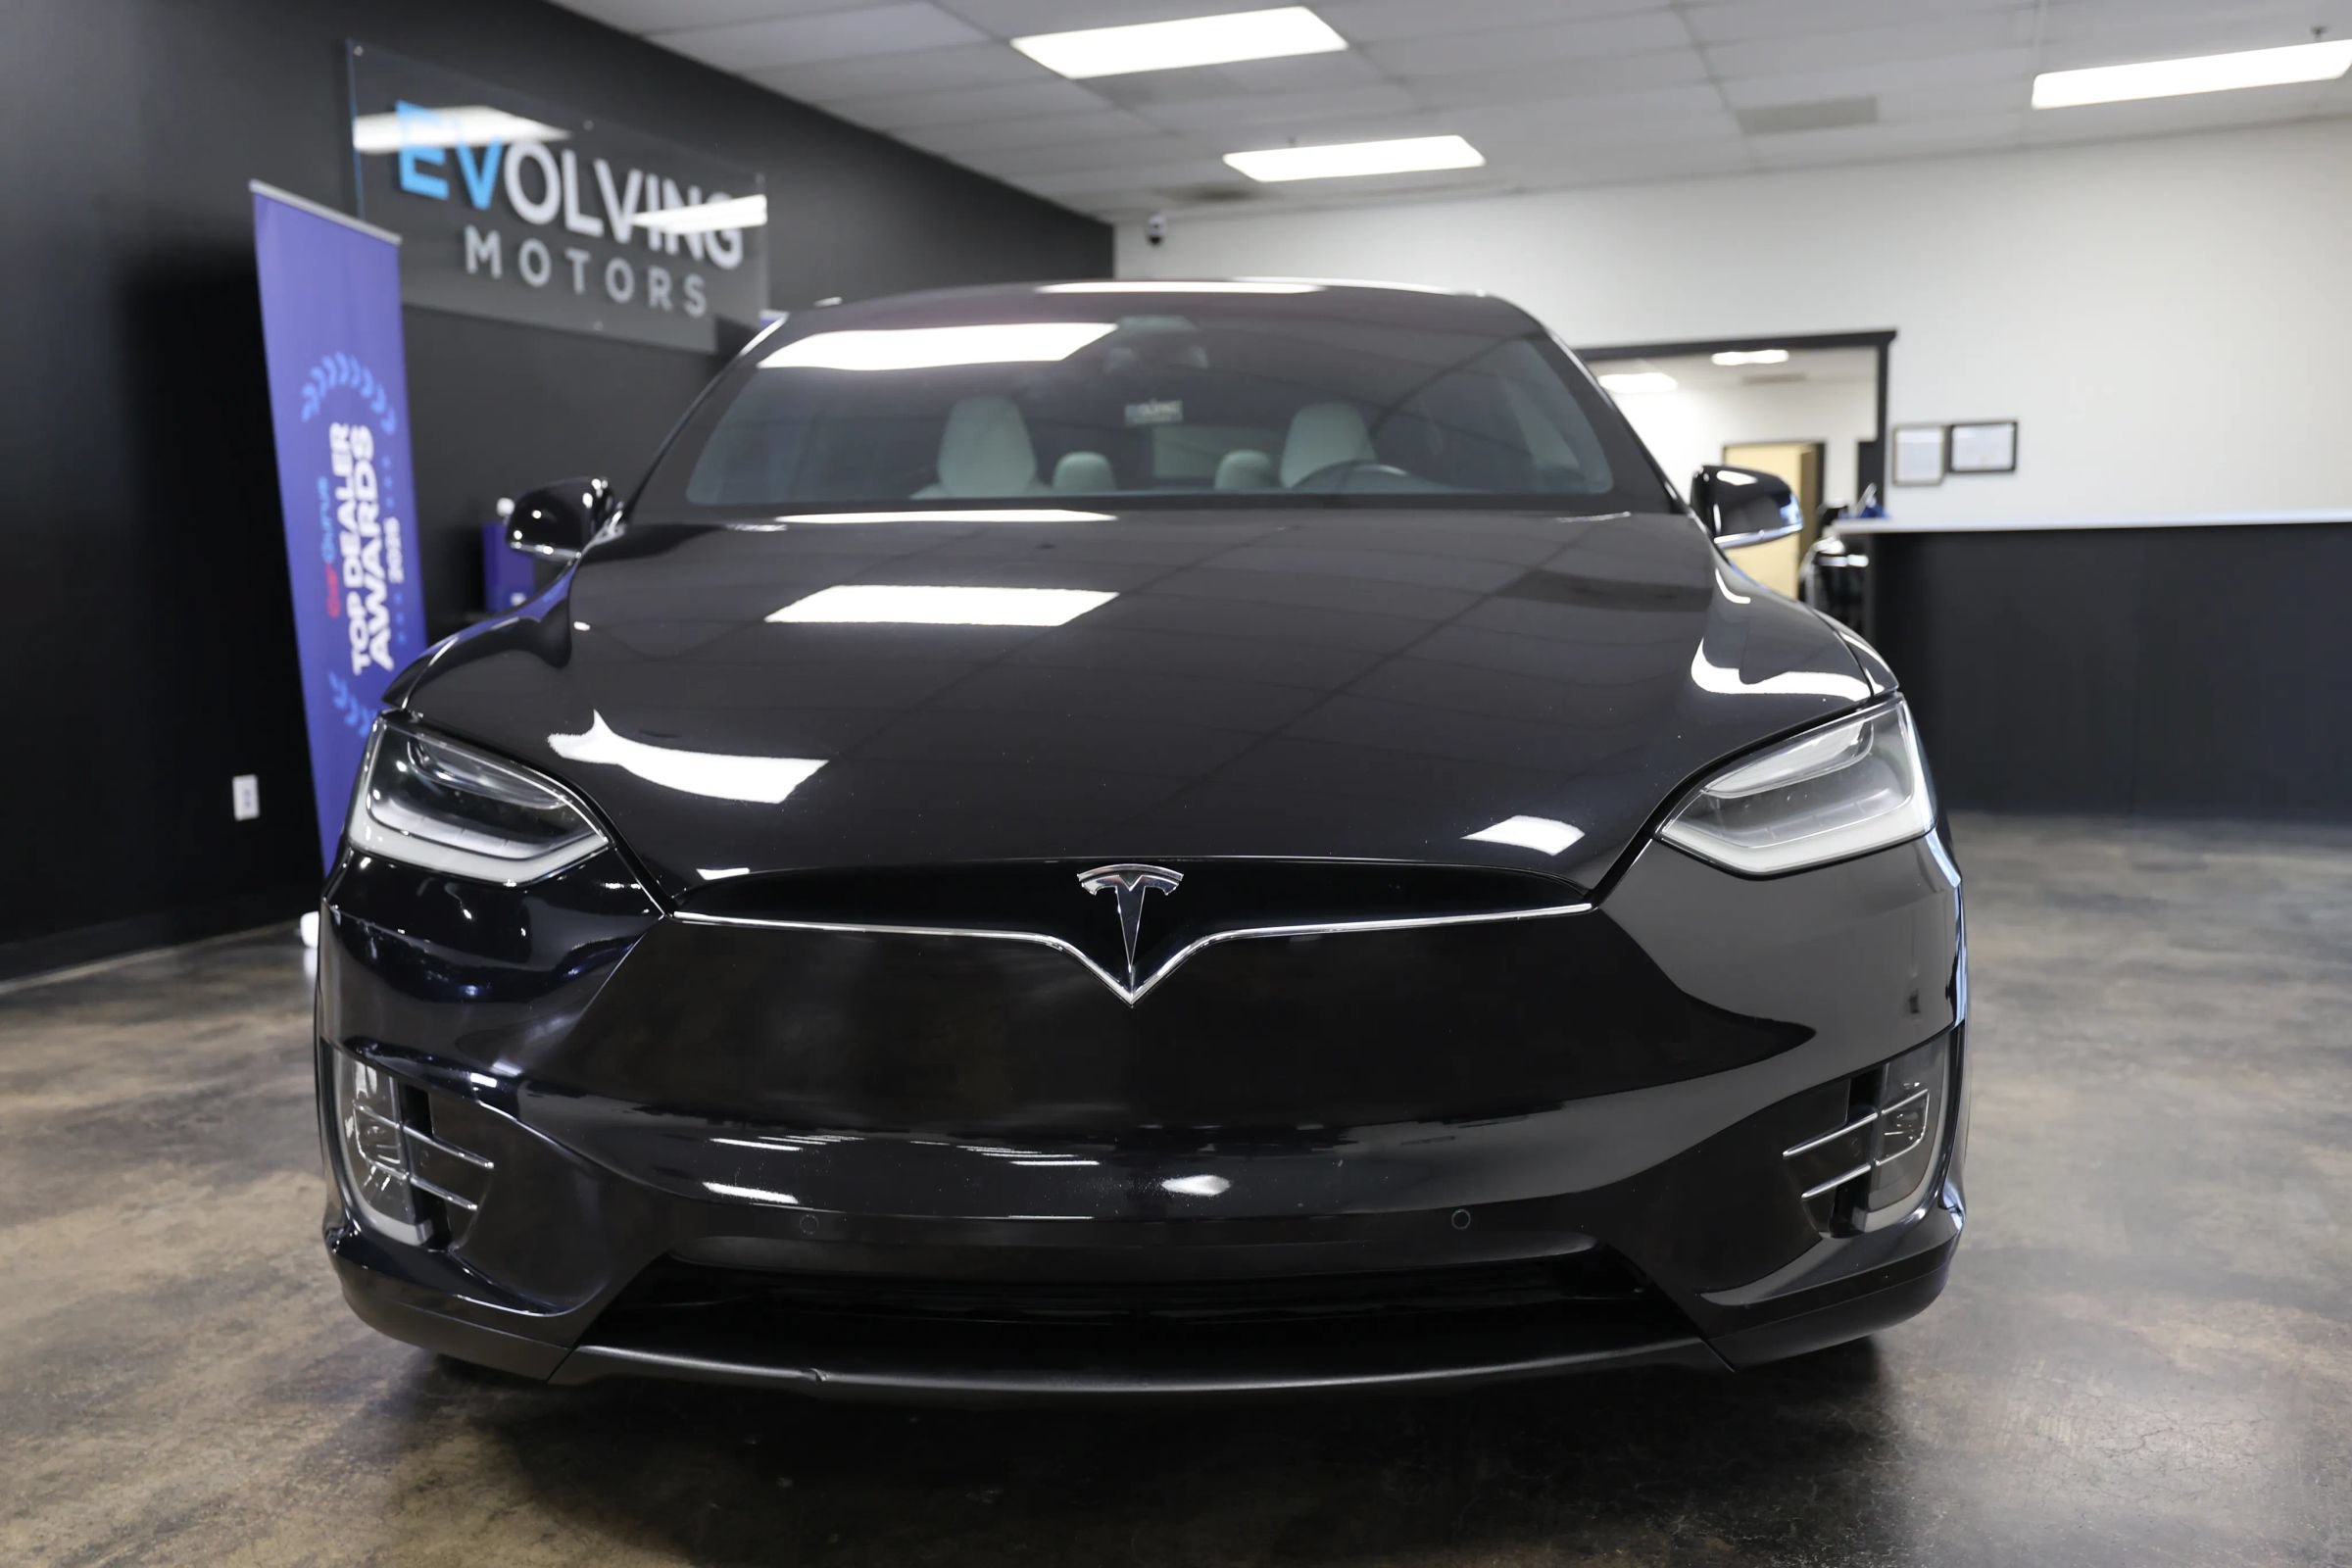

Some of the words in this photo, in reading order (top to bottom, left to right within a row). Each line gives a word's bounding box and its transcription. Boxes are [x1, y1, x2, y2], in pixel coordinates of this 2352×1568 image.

[396, 100, 744, 270] EVOLVING
[465, 224, 707, 318] MOTORS
[329, 422, 365, 588] DEALER
[350, 424, 394, 670] AWARDS
[346, 591, 371, 676] TOP
